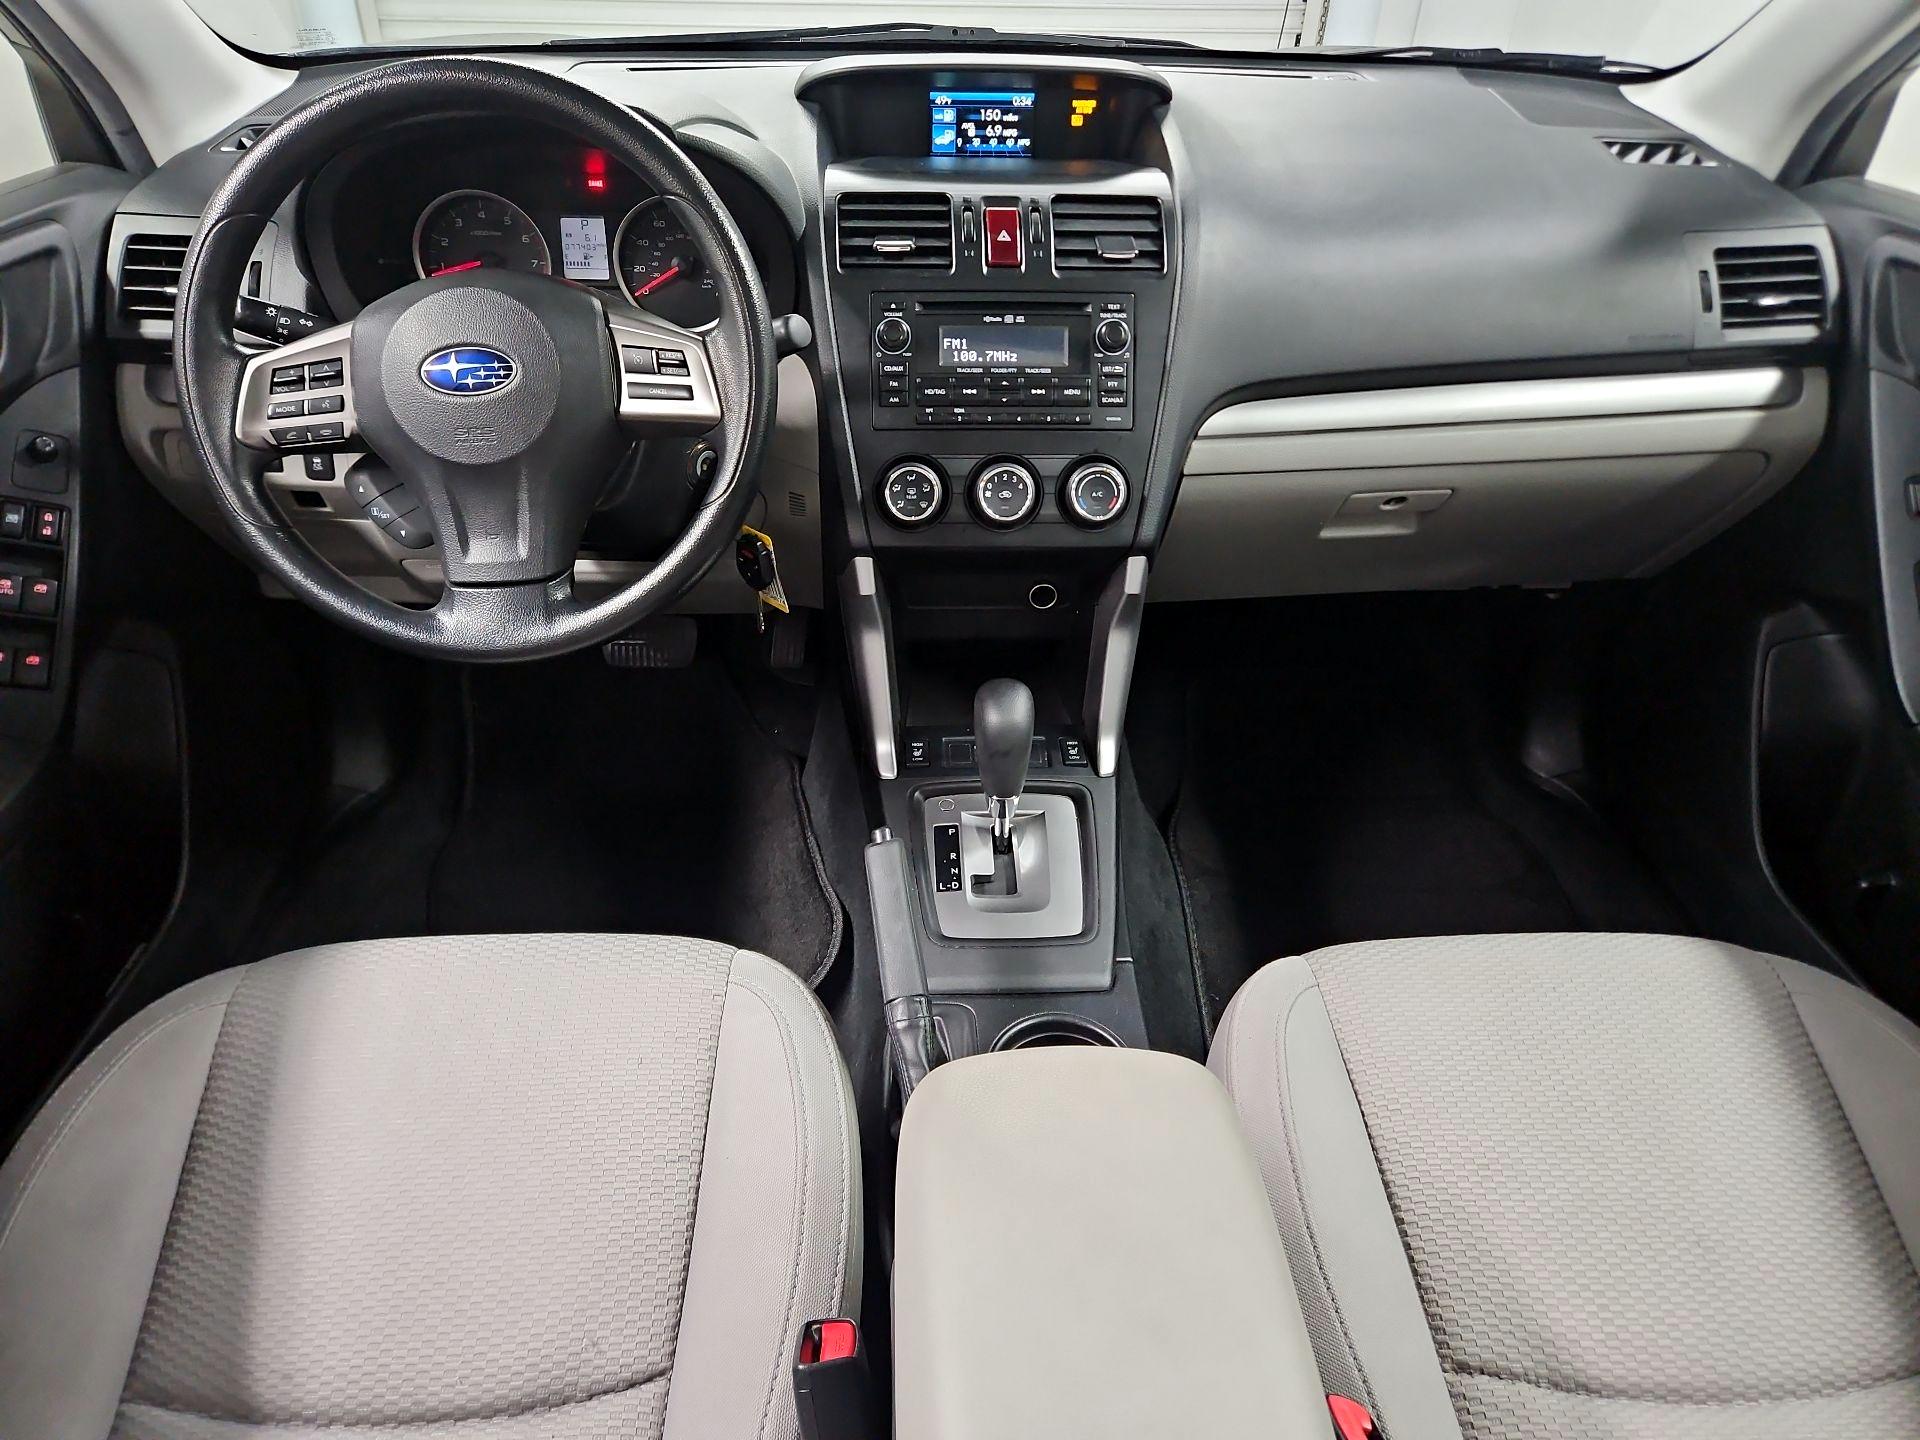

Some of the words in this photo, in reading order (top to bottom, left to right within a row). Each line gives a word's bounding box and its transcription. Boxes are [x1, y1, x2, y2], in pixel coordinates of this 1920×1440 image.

[980, 109, 1001, 121] 150
[985, 125, 1002, 137] 6.9
[455, 218, 462, 227] 3
[503, 217, 512, 225] 5
[580, 220, 588, 230] P
[531, 260, 538, 268] 7
[634, 265, 646, 273] 20
[943, 338, 967, 349] FM1
[953, 350, 1017, 362] 100.7MHz
[648, 387, 668, 395] CANCEL
[275, 404, 297, 413] MODE
[1002, 473, 1008, 481] 2
[1012, 475, 1017, 483] 3
[986, 482, 993, 490] 0
[948, 828, 956, 836] P
[950, 852, 957, 860] R
[950, 867, 959, 875] N
